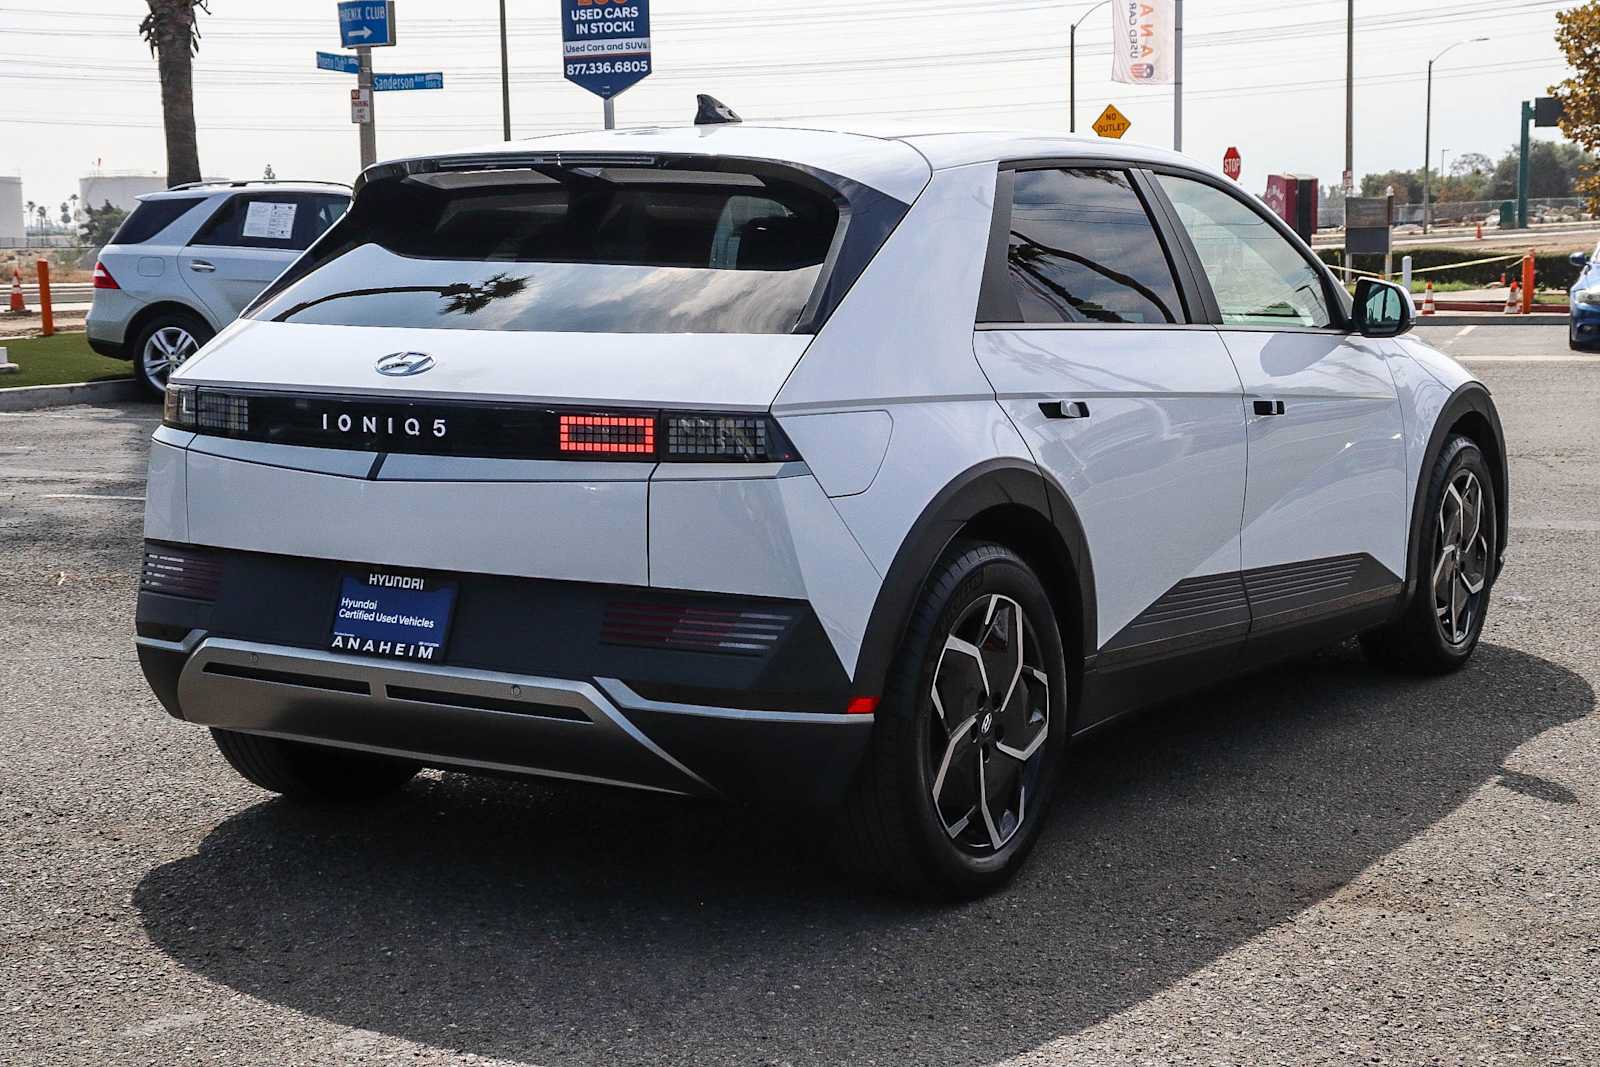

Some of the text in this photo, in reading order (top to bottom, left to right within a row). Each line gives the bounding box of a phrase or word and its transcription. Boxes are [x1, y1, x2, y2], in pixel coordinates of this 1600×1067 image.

[365, 6, 385, 20] CLUB
[571, 6, 639, 20] USED CARS
[576, 21, 635, 34] IN STOCK!
[566, 45, 585, 53] Used
[607, 43, 624, 51] and
[625, 42, 648, 50] SUVs
[566, 61, 648, 75] 877.336.6805
[374, 77, 414, 89] Sanderson
[1105, 113, 1117, 121] NO
[1097, 122, 1126, 133] OUTLET
[1224, 159, 1241, 174] STOP
[322, 413, 447, 438] IONIQ 5
[368, 573, 425, 591] HYUNDAI
[341, 596, 378, 610] Hyundai
[338, 608, 435, 629] Certified Used Vehicles
[331, 635, 434, 660] ANAHEIM
